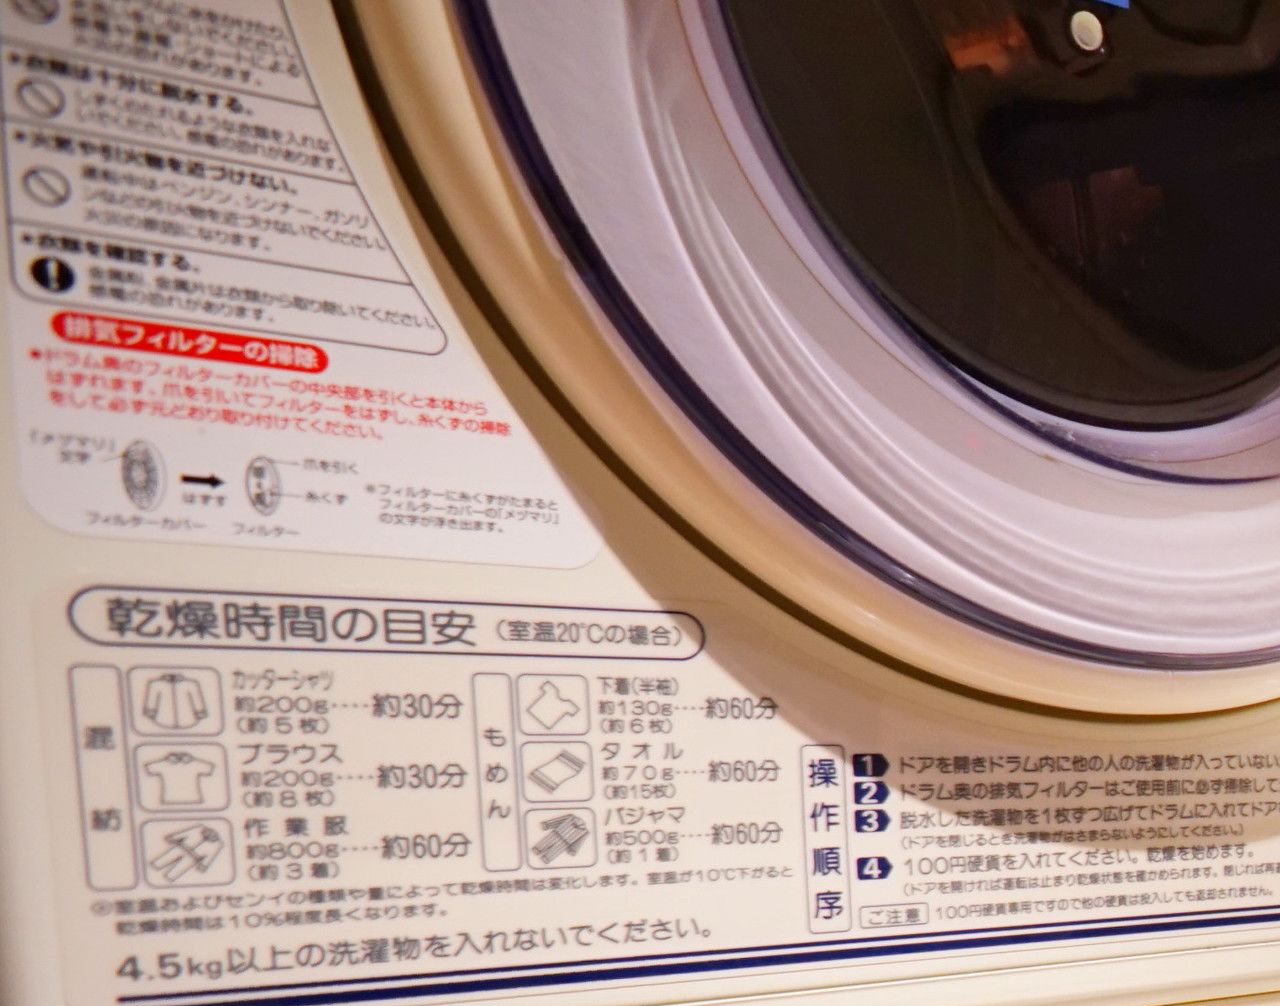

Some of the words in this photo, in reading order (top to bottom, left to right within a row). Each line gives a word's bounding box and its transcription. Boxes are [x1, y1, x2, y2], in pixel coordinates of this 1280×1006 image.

[107, 597, 477, 647] 乾燥時間の目安
[372, 693, 464, 720] 約30分
[705, 696, 779, 720] 約60分
[237, 742, 345, 766] ブラウス
[601, 743, 684, 761] タオル
[376, 764, 468, 789] 約30分
[484, 727, 511, 821] もめん
[707, 759, 782, 784] 約60分
[859, 755, 875, 777] 1
[862, 782, 879, 803] 2
[604, 805, 686, 826] パジャマ
[864, 811, 879, 832] 3
[711, 820, 784, 846] 約60分
[808, 758, 844, 922] 操作順序
[381, 833, 472, 860] 約60分
[866, 857, 883, 879] 4
[903, 842, 1254, 876] 100円硬貨を入れてください。乾燥を始めます。
[867, 906, 920, 926] ご注意
[116, 917, 712, 981] 4.5kg以上の洗濯物を入れないでください。
